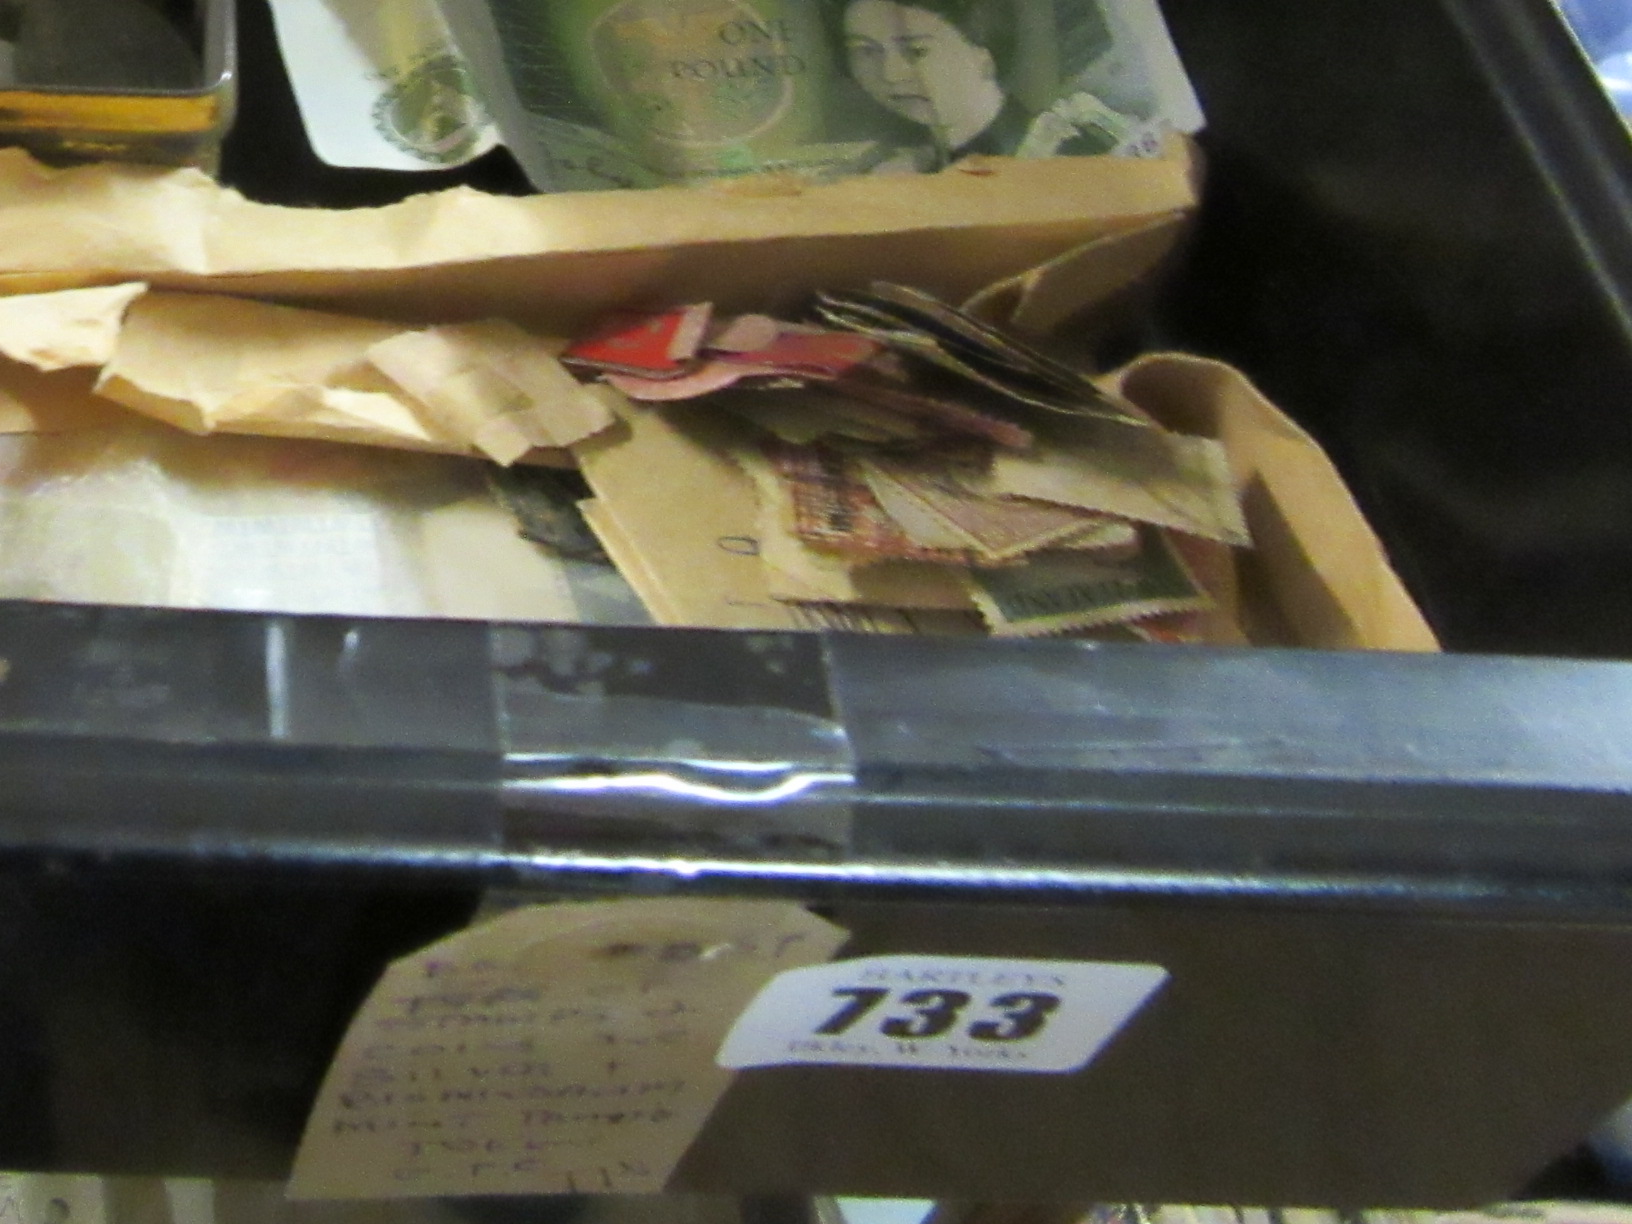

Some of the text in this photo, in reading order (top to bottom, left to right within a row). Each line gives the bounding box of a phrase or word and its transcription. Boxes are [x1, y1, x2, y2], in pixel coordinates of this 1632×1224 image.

[719, 19, 792, 46] ONE
[672, 53, 807, 79] POUND
[813, 986, 1062, 1042] 733
